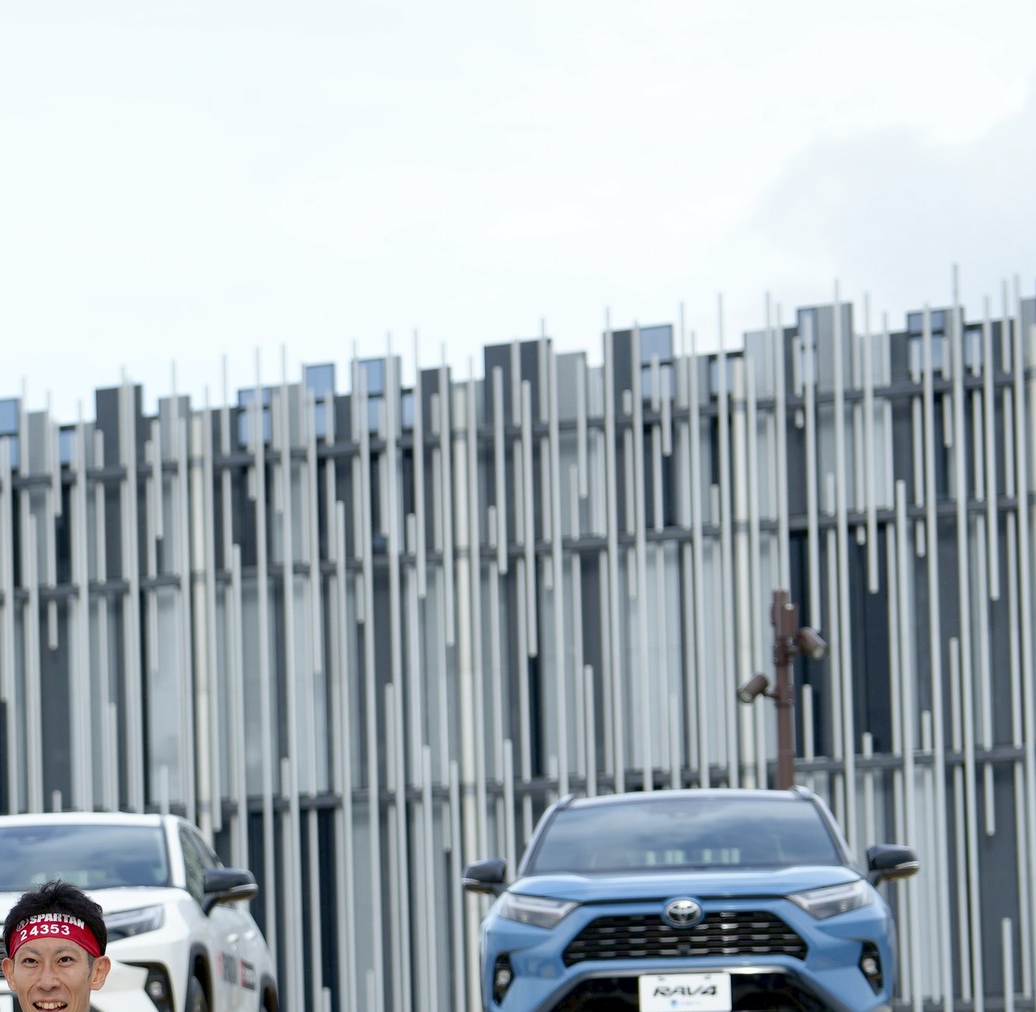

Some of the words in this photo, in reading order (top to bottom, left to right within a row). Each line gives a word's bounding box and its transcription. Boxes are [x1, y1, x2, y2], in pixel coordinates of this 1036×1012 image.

[29, 913, 85, 930] SPARTAN
[20, 924, 70, 941] 24353
[653, 985, 717, 998] RAV4
